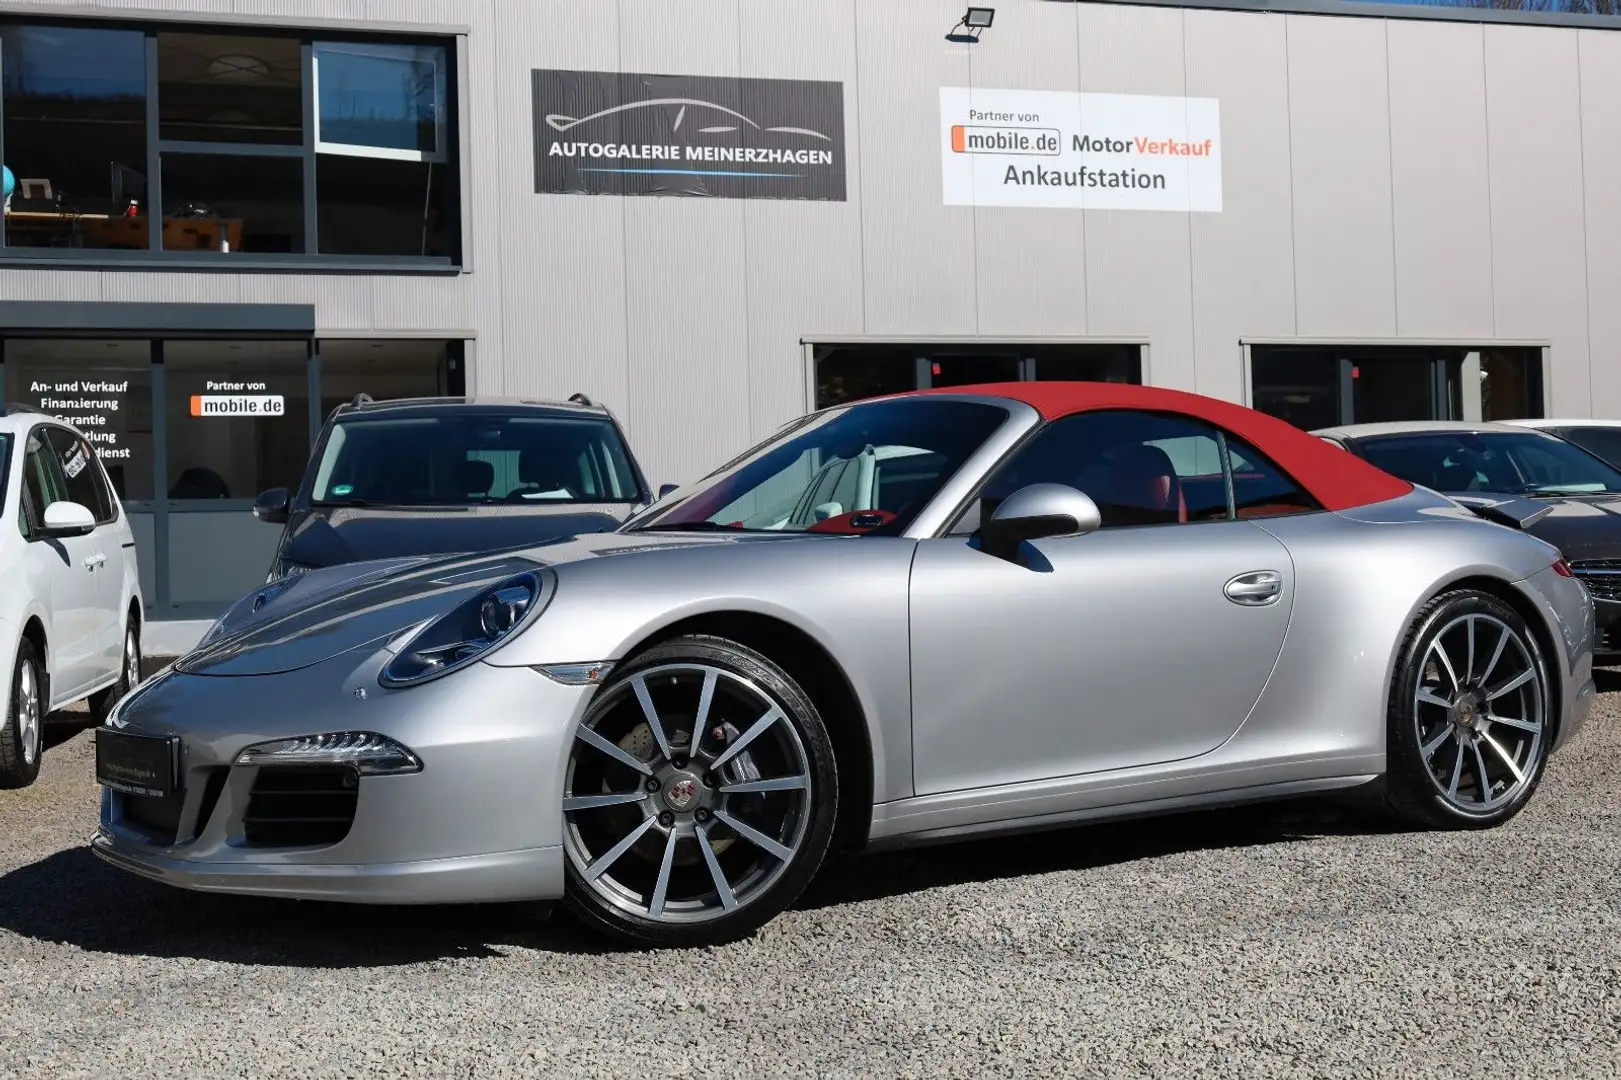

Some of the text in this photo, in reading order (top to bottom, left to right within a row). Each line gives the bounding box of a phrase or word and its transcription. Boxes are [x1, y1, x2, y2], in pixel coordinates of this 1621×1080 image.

[968, 109, 1040, 123] Partner von
[967, 131, 1212, 156] mobile.de MotorVerkauf
[548, 141, 833, 165] AUTOGALERIE MEINERZHAGEN
[1003, 164, 1166, 189] Ankaufstation
[30, 381, 128, 393] An- und Verkauf
[206, 381, 266, 391] Partner von
[40, 397, 119, 411] Finanzierung
[204, 399, 282, 413] mobile.de
